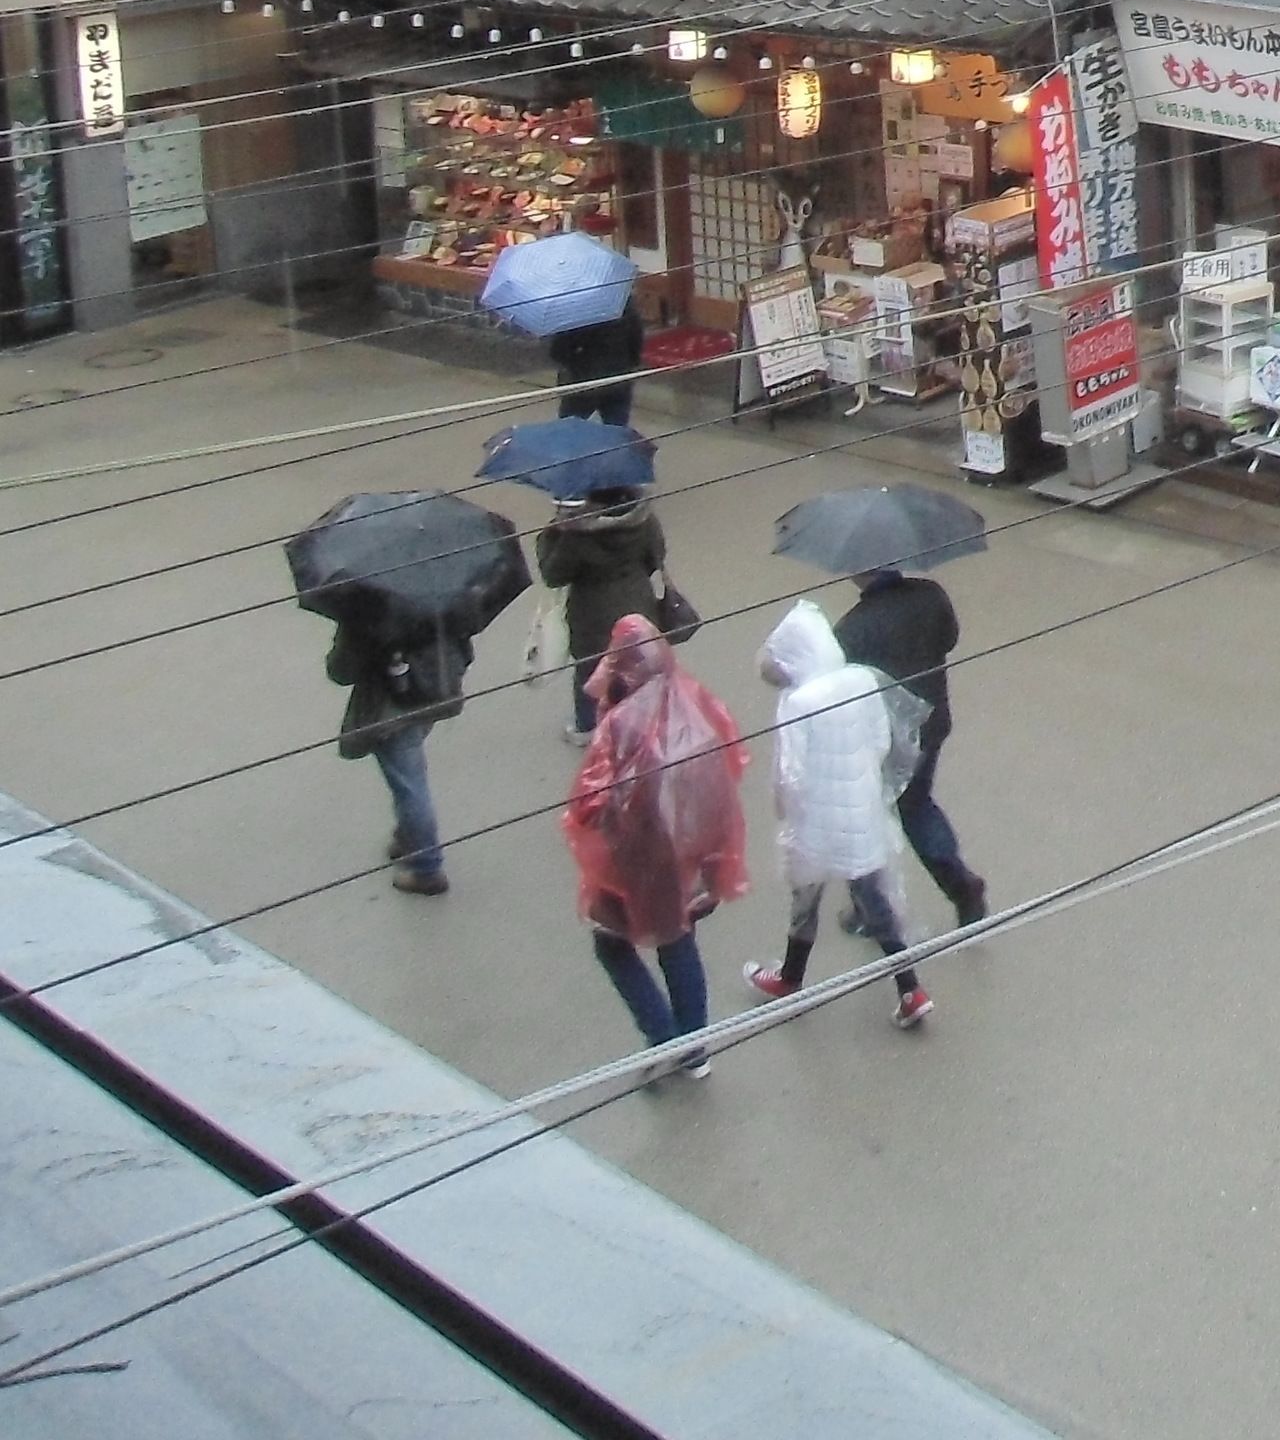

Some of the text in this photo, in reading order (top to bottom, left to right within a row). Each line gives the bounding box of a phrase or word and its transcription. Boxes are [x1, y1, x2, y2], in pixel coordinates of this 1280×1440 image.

[85, 22, 115, 130] やまだ屋
[1184, 259, 1230, 278] 生食用
